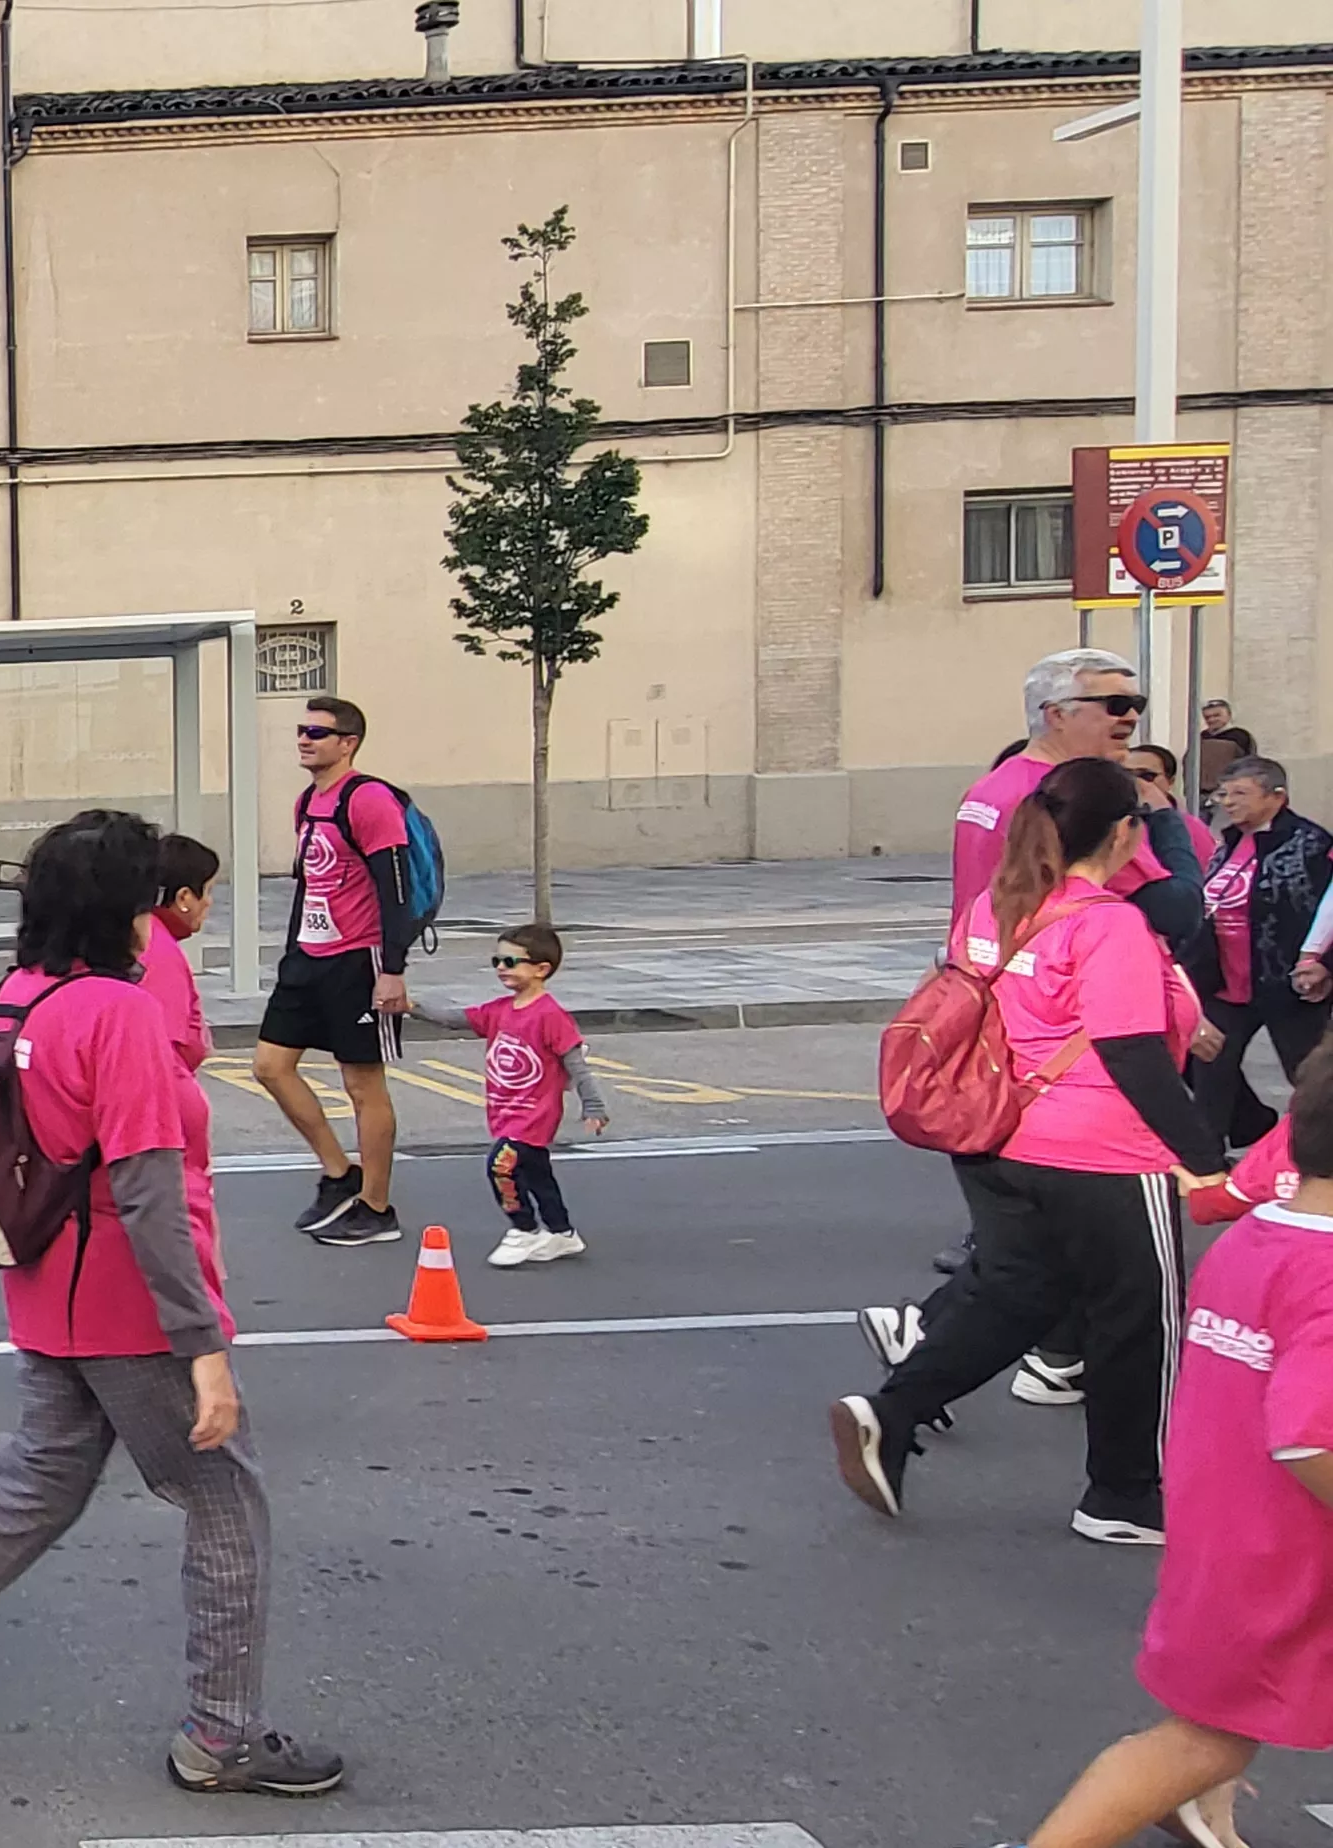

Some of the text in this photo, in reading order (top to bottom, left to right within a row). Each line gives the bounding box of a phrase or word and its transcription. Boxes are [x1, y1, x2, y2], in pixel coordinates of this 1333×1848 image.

[1162, 530, 1174, 546] P
[1158, 576, 1183, 588] BUS
[290, 599, 304, 615] 2
